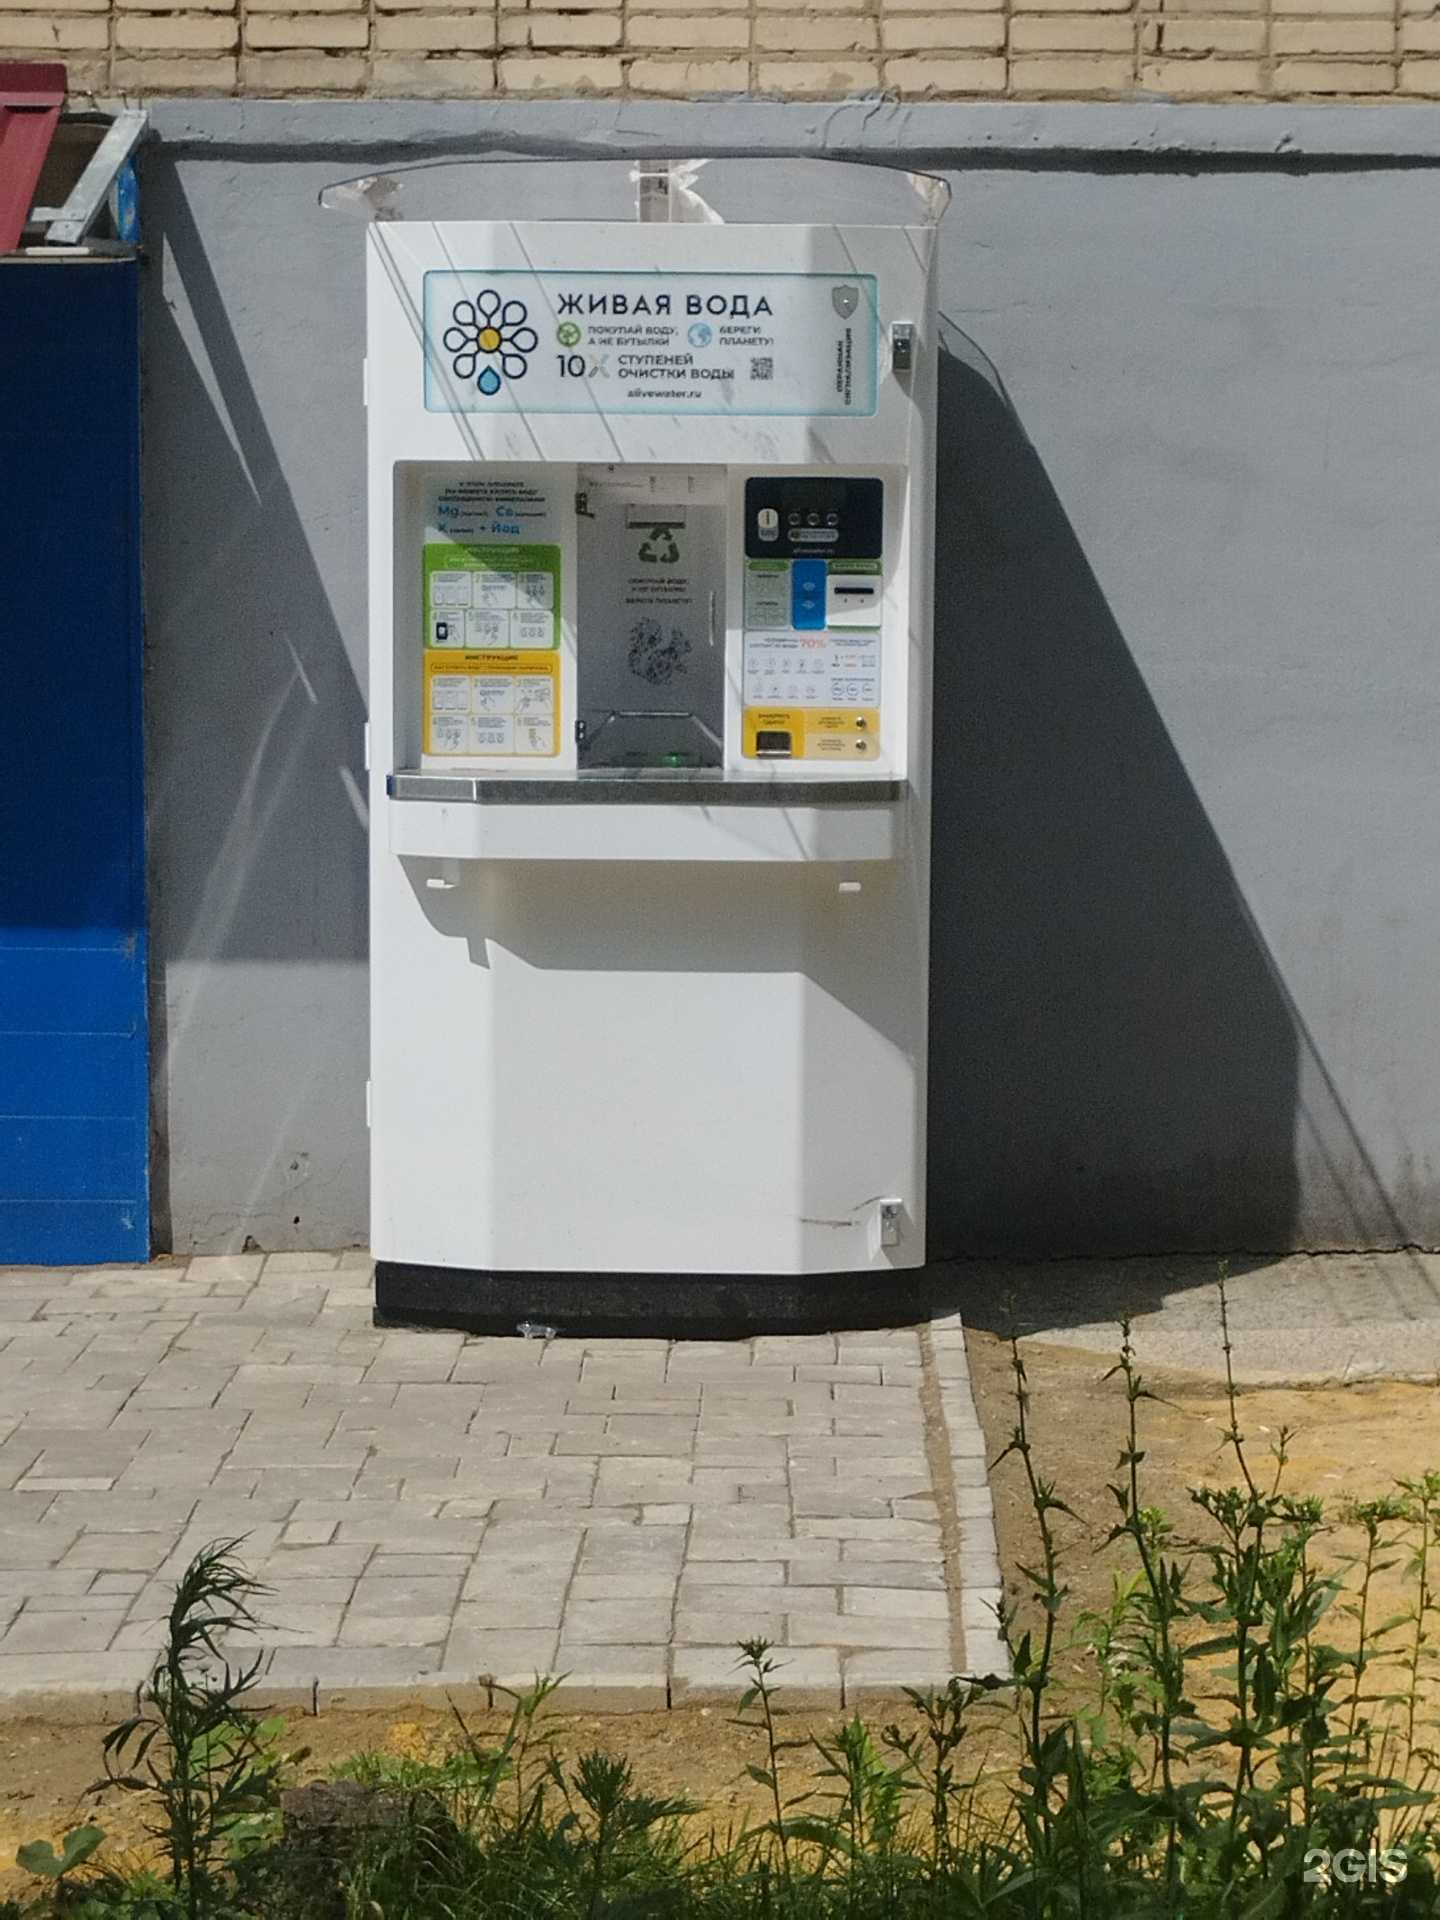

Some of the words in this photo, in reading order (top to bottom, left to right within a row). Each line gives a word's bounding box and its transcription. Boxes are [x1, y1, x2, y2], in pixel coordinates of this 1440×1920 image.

[557, 293, 671, 316] ЖИВАЯ
[686, 294, 774, 318] ВОДА
[587, 325, 642, 335] ПОКУПАЙ
[616, 339, 670, 347] БУТЫЛКИ
[617, 353, 694, 366] СТУПЕНЕЙ
[617, 369, 687, 379] ОЧИСТКИ
[690, 369, 735, 380] ВОДЫ
[627, 388, 702, 399] alivewater.ru
